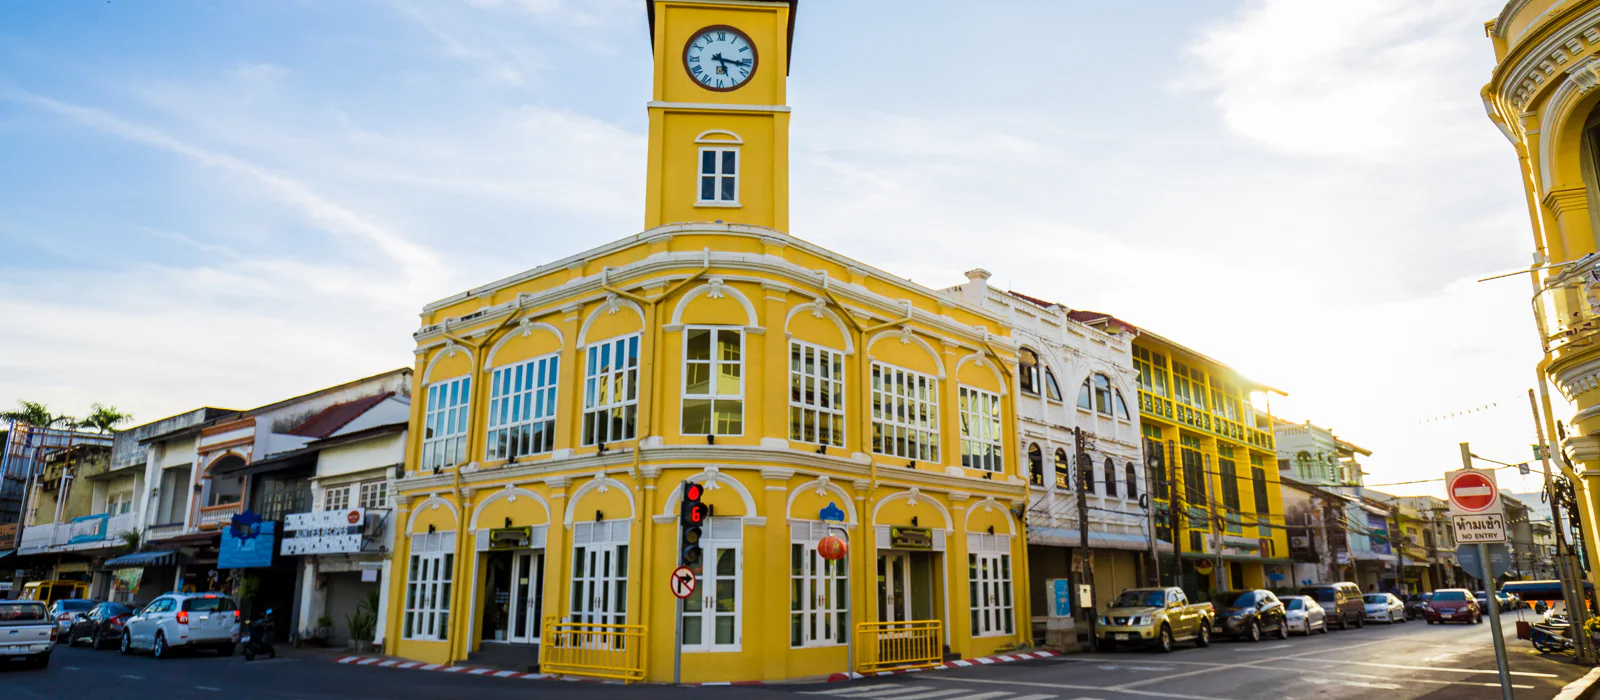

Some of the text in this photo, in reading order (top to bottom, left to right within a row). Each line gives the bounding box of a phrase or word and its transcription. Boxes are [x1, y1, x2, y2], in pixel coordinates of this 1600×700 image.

[717, 32, 726, 41] XII
[691, 506, 701, 523] 6
[1457, 516, 1501, 530] ห้ามเข้า
